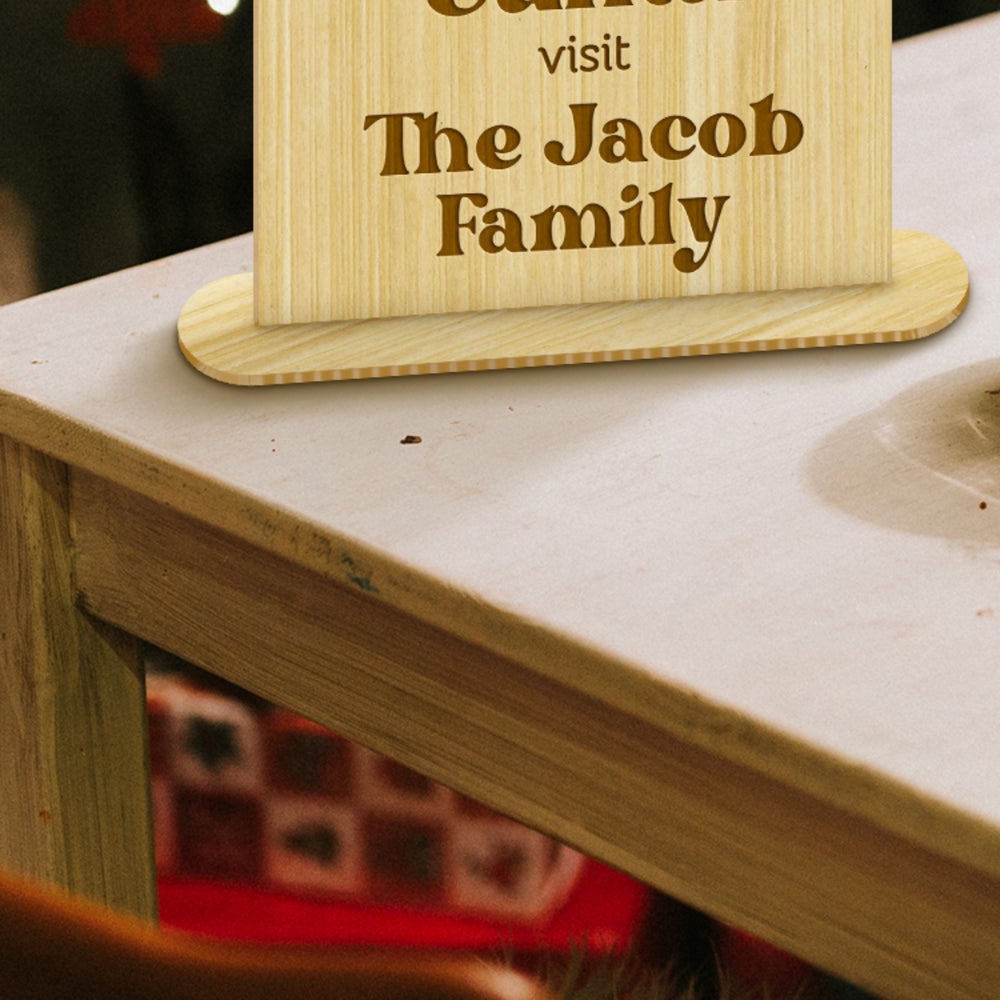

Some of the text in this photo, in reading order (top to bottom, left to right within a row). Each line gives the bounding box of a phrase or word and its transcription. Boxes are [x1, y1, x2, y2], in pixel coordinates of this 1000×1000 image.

[538, 33, 631, 74] visit
[363, 93, 805, 177] The Jacob
[436, 182, 731, 274] Family
